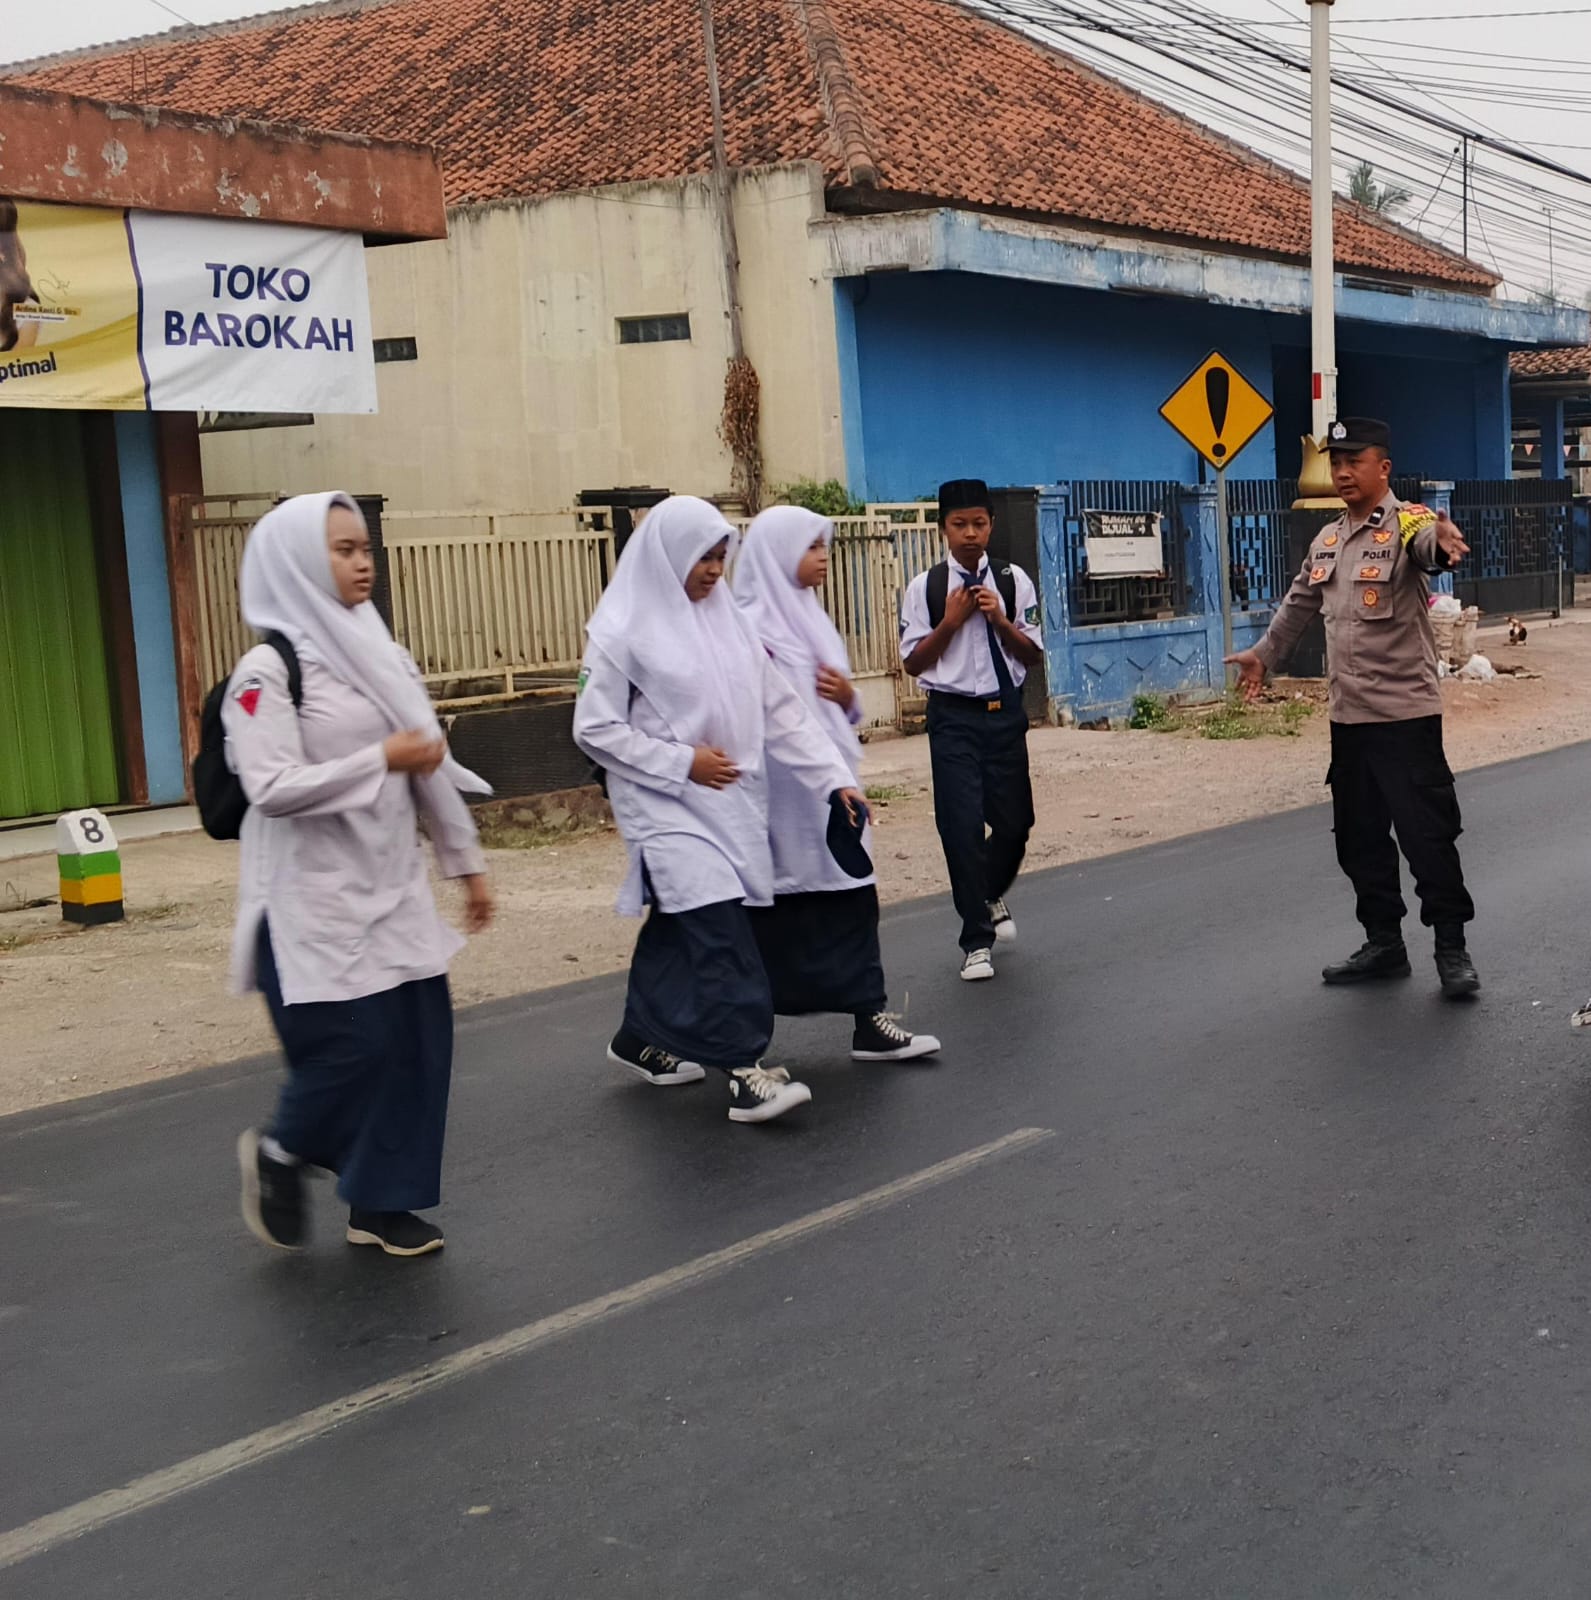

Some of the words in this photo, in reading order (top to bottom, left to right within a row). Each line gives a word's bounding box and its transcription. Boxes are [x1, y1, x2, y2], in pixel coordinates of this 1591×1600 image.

[205, 262, 311, 302] TOKO
[164, 310, 354, 352] BAROKAH
[1101, 524, 1133, 535] DIJUAL
[1362, 549, 1391, 560] POLRI
[79, 817, 104, 843] 8
